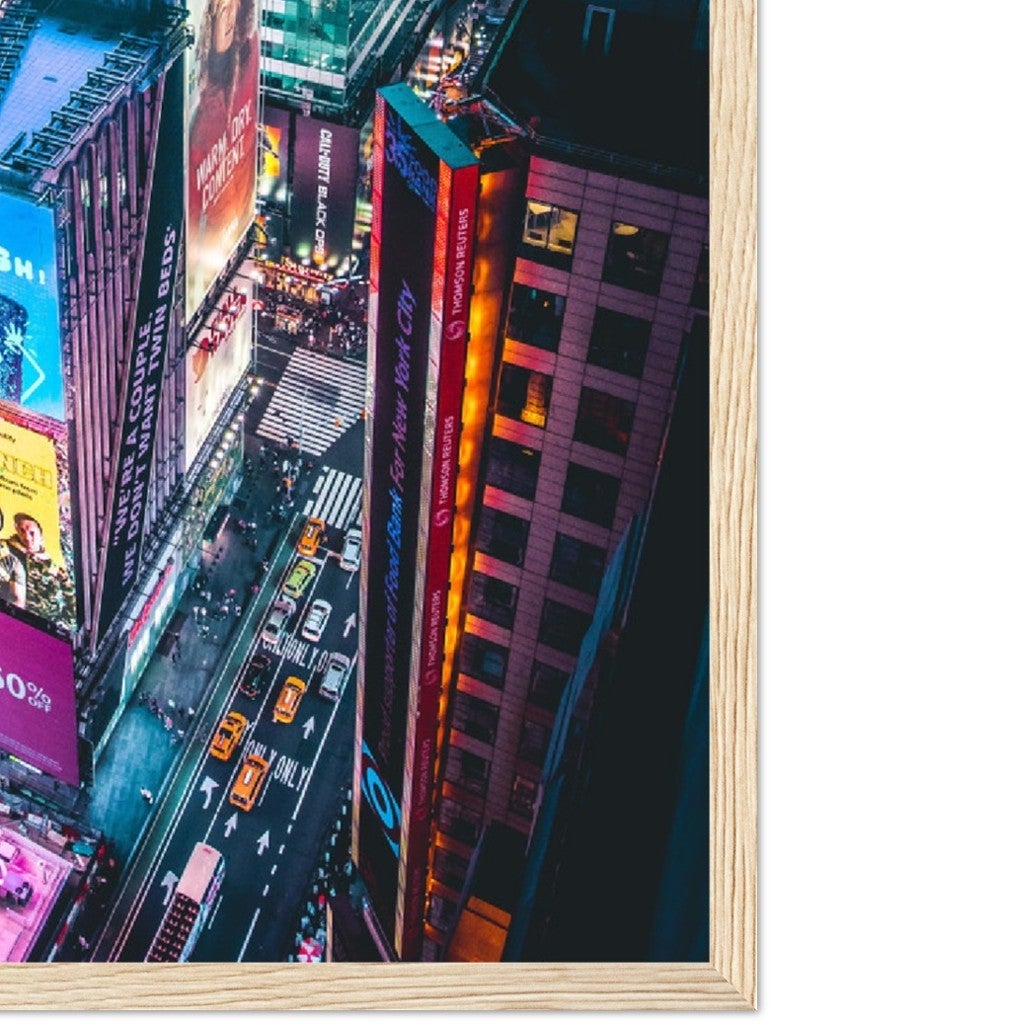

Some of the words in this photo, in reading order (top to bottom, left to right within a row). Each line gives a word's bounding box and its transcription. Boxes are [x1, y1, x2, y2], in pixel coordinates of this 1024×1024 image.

[315, 185, 329, 228] BLACK
[456, 207, 470, 260] REUTERS
[397, 278, 417, 336] City
[451, 260, 466, 316] THOMSON
[147, 303, 168, 376] TWIN
[394, 335, 412, 393] York
[125, 425, 139, 446] A
[137, 383, 157, 460] WANT
[392, 390, 409, 452] New
[443, 414, 456, 456] REUTERS
[390, 450, 406, 493] For
[439, 457, 452, 505] THOMSON
[127, 463, 147, 541] DON'T
[386, 487, 404, 548] Bank
[121, 542, 138, 588] WE
[286, 639, 320, 670] ONLY
[27, 695, 52, 713] OFF
[274, 754, 311, 792] ONLY
